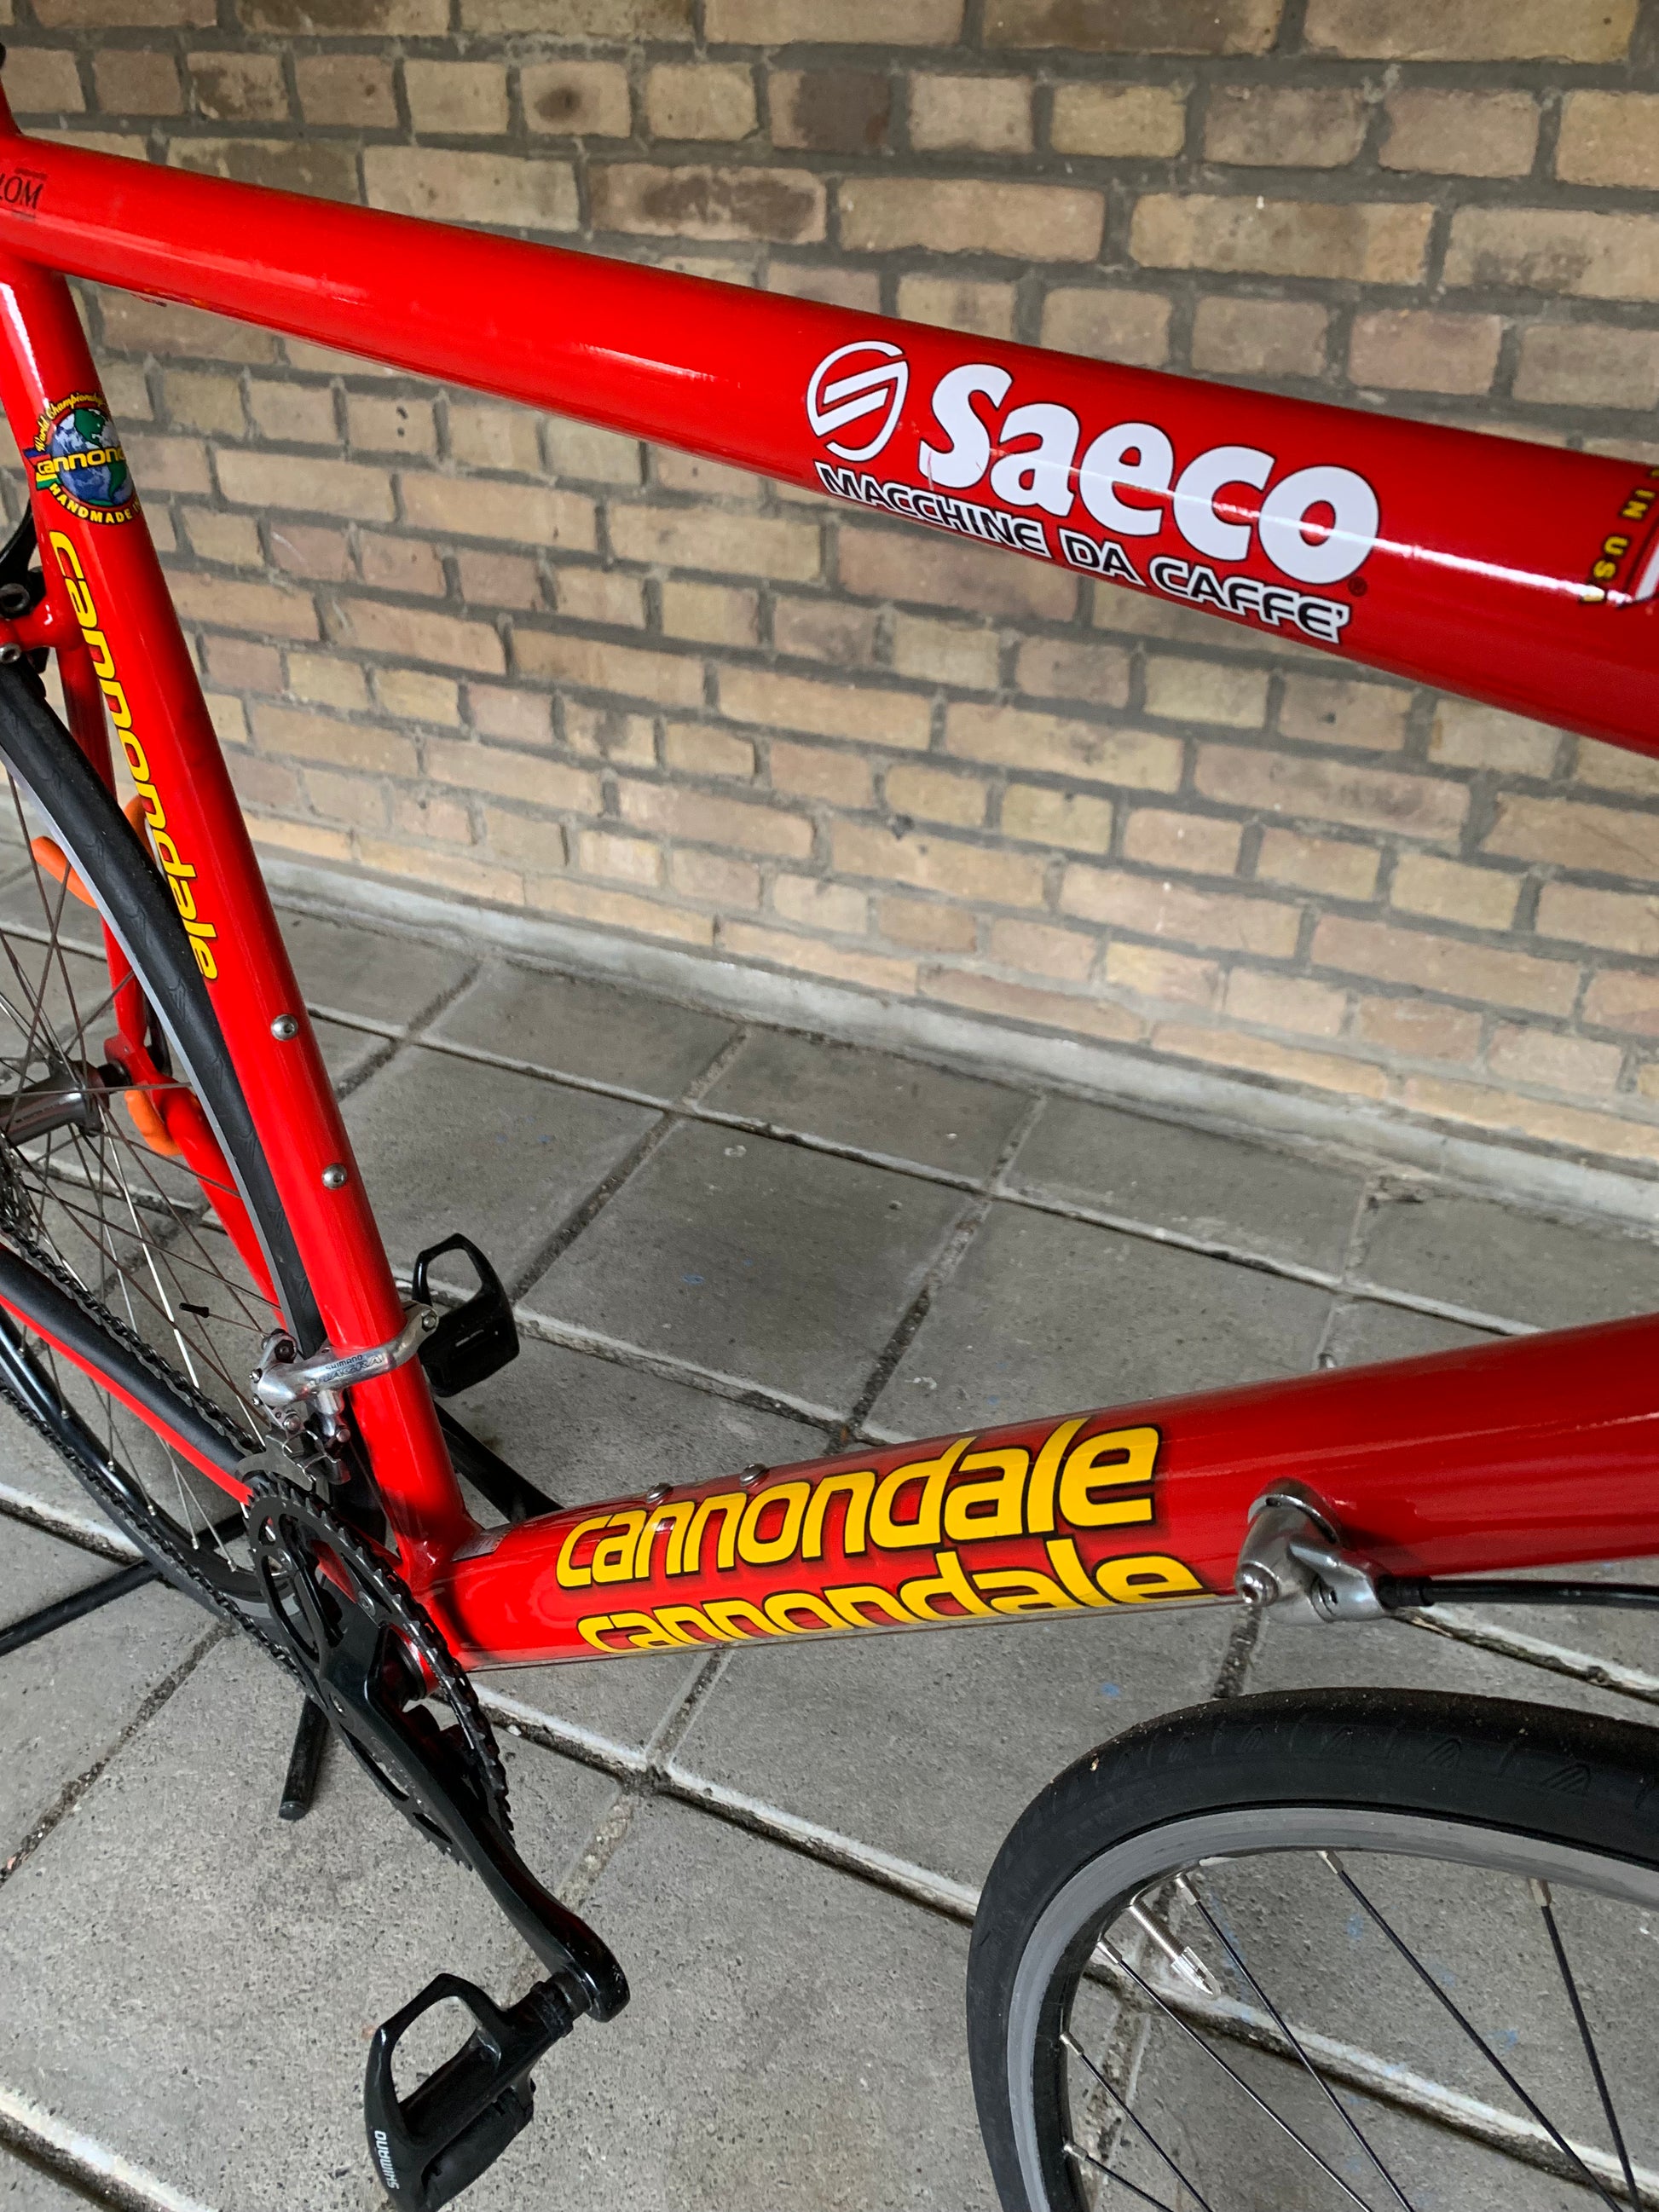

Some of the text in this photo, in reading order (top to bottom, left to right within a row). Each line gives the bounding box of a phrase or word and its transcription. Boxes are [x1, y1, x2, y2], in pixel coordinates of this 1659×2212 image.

[34, 415, 50, 452] World
[919, 364, 1380, 584] Saeco
[49, 482, 133, 524] HANDMADE
[815, 462, 1049, 556] MACCHINE
[1059, 528, 1146, 587] DA
[49, 530, 219, 981] cannondale
[326, 1354, 363, 1371] SHIMANO
[556, 1417, 1163, 1589] cannondale
[373, 2130, 400, 2190] SHIMANO
